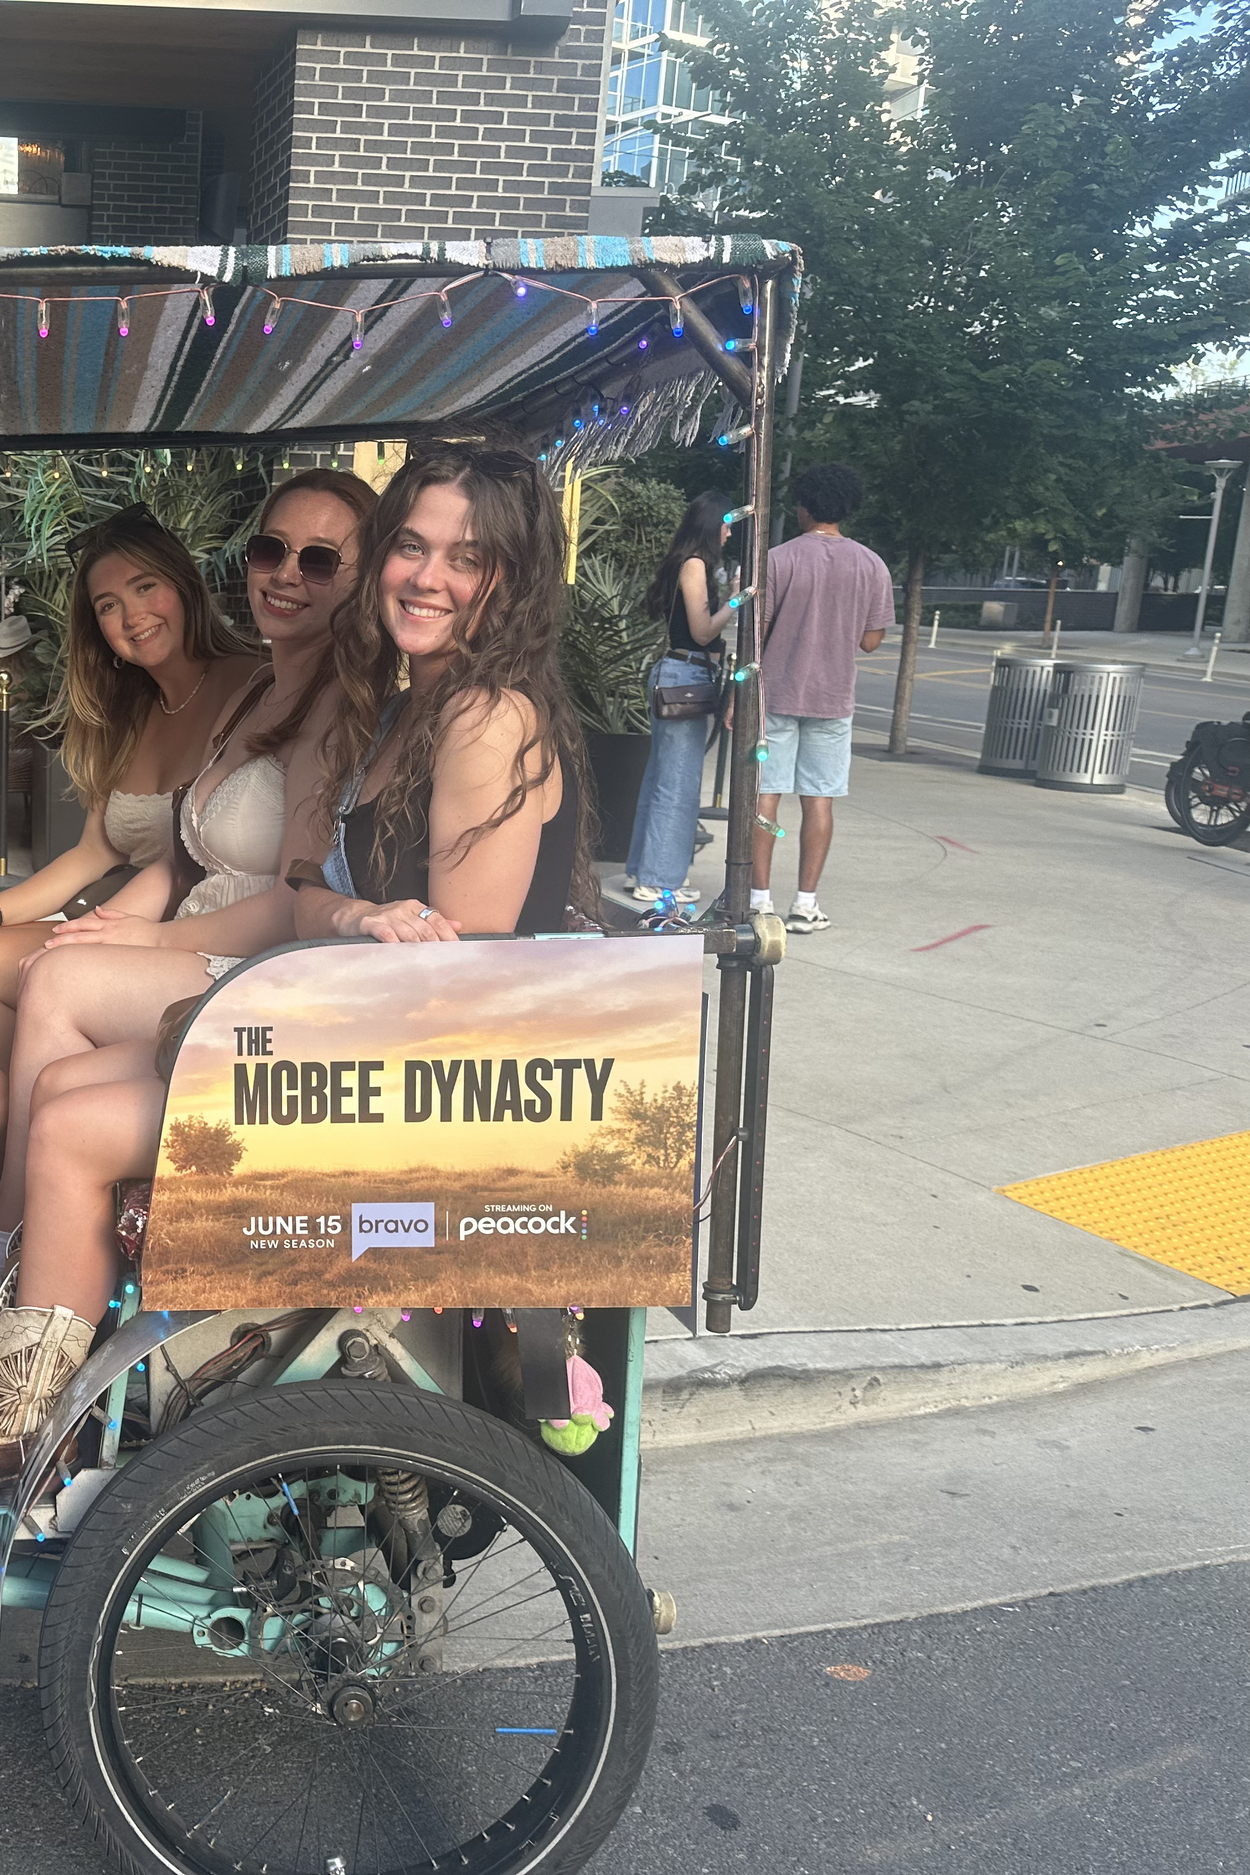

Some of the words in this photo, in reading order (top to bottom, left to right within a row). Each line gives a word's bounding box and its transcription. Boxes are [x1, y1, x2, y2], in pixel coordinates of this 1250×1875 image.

[233, 1026, 273, 1056] THE
[234, 1060, 384, 1125] MCBEE
[405, 1058, 615, 1123] DYNASTY
[484, 1204, 535, 1213] STREAMING
[538, 1204, 553, 1212] ON
[243, 1215, 309, 1235] JUNE
[316, 1215, 341, 1234] 15
[358, 1213, 429, 1234] bravo
[459, 1209, 577, 1241] peacock
[250, 1239, 281, 1250] NEW
[283, 1238, 335, 1249] SEASON
